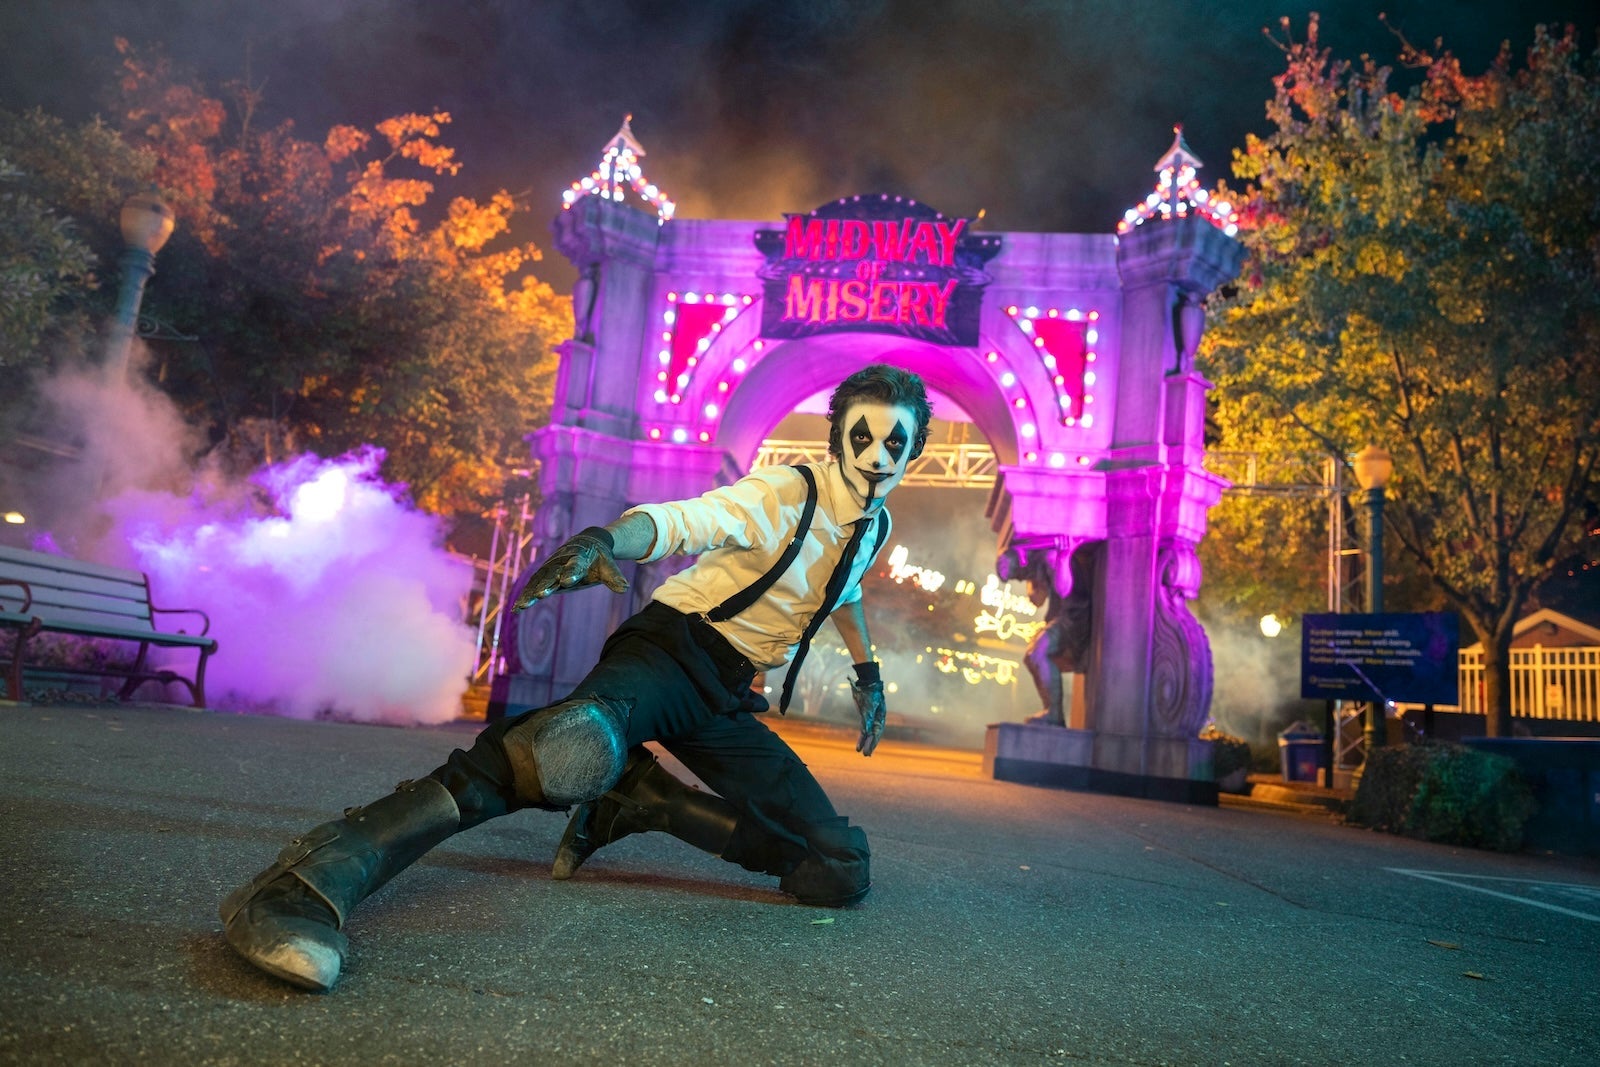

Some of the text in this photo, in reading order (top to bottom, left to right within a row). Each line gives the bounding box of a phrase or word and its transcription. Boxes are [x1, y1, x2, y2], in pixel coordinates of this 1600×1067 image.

[784, 216, 966, 266] MIDWAY
[856, 261, 886, 281] OF
[783, 275, 958, 328] MISERY
